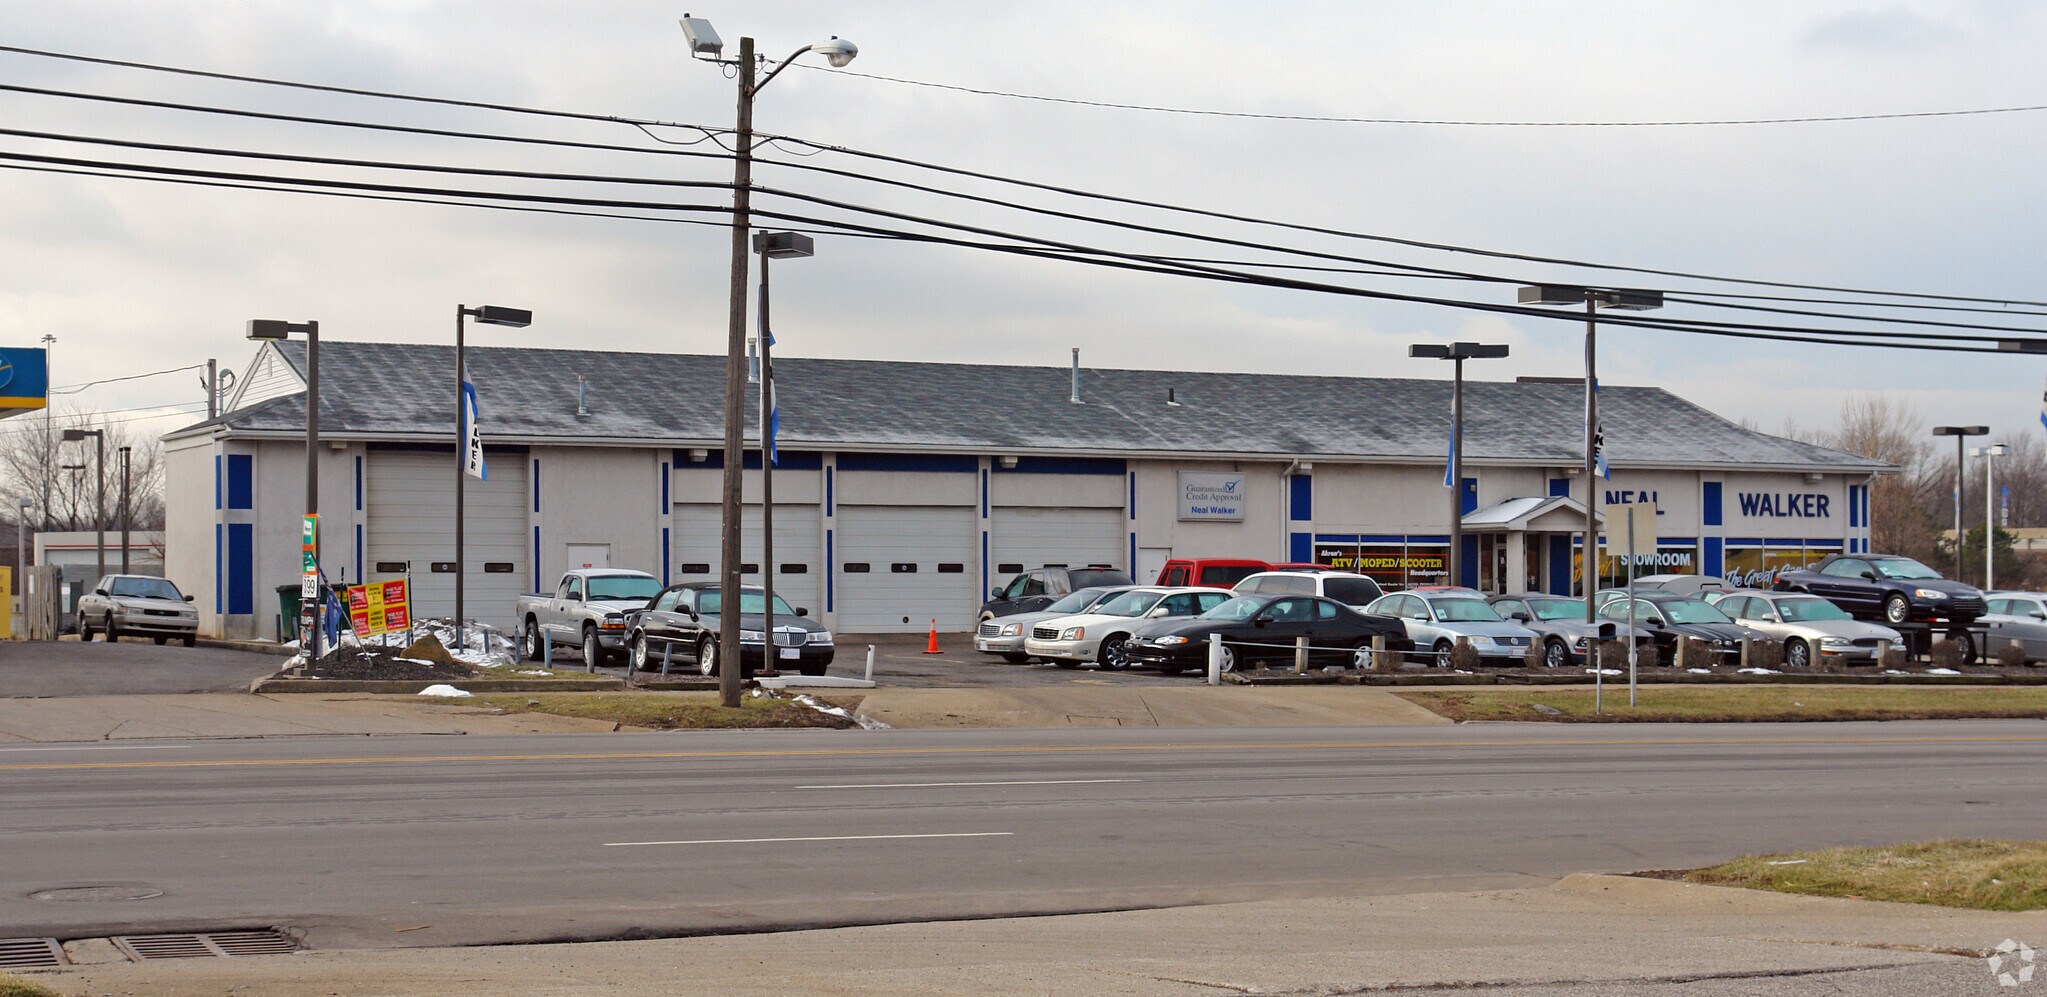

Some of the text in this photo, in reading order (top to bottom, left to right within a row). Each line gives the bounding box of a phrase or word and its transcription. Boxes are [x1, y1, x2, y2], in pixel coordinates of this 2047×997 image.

[471, 417, 480, 471] LKER
[1186, 484, 1226, 492] Guaranteed
[1210, 493, 1241, 502] Approval
[1191, 506, 1235, 514] Neal Walker
[1739, 493, 1830, 518] WALKER
[1620, 553, 1690, 566] SOWROOM
[1726, 566, 1743, 587] The
[1744, 565, 1777, 588] Great
